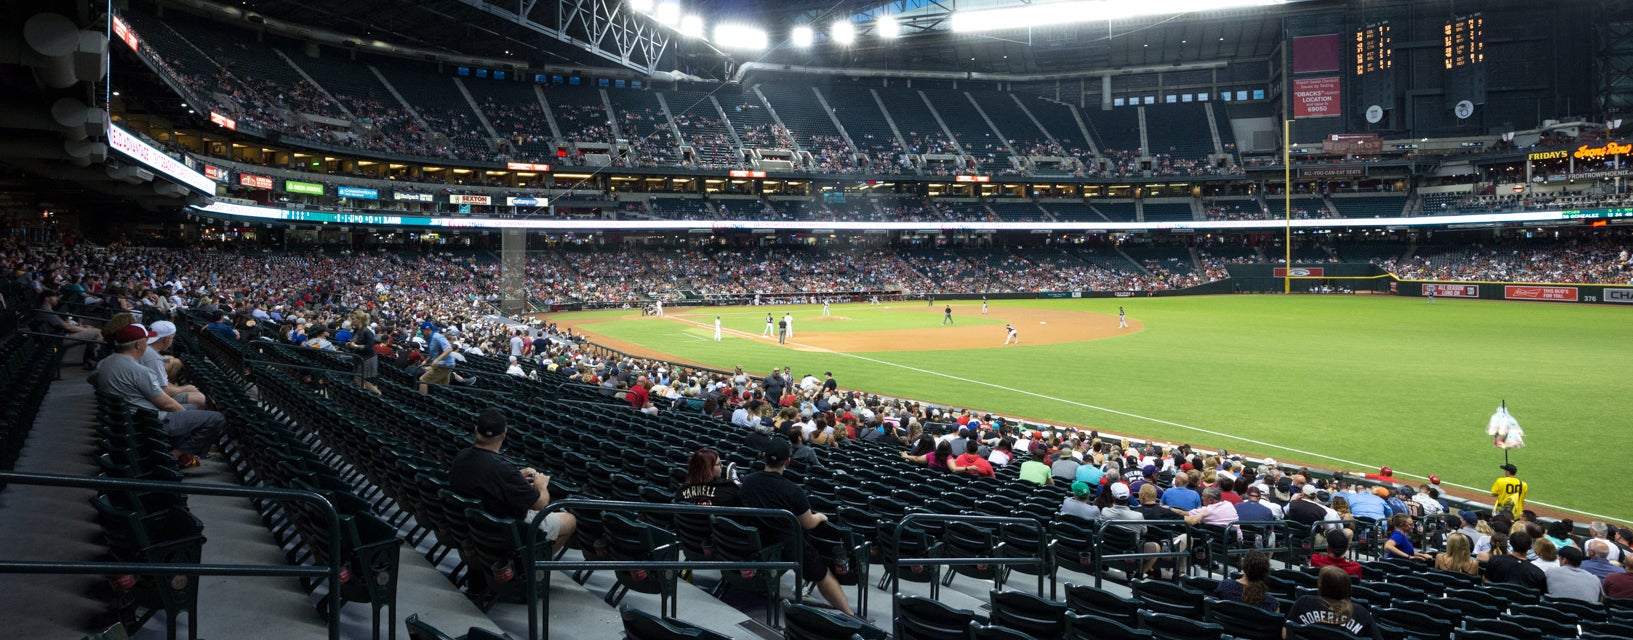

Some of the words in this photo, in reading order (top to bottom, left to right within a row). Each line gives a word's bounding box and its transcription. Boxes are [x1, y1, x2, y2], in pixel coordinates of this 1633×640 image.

[1528, 150, 1567, 160] FRIDAY'S
[682, 485, 716, 499] YARNELL
[1299, 610, 1363, 635] ROBERSON
